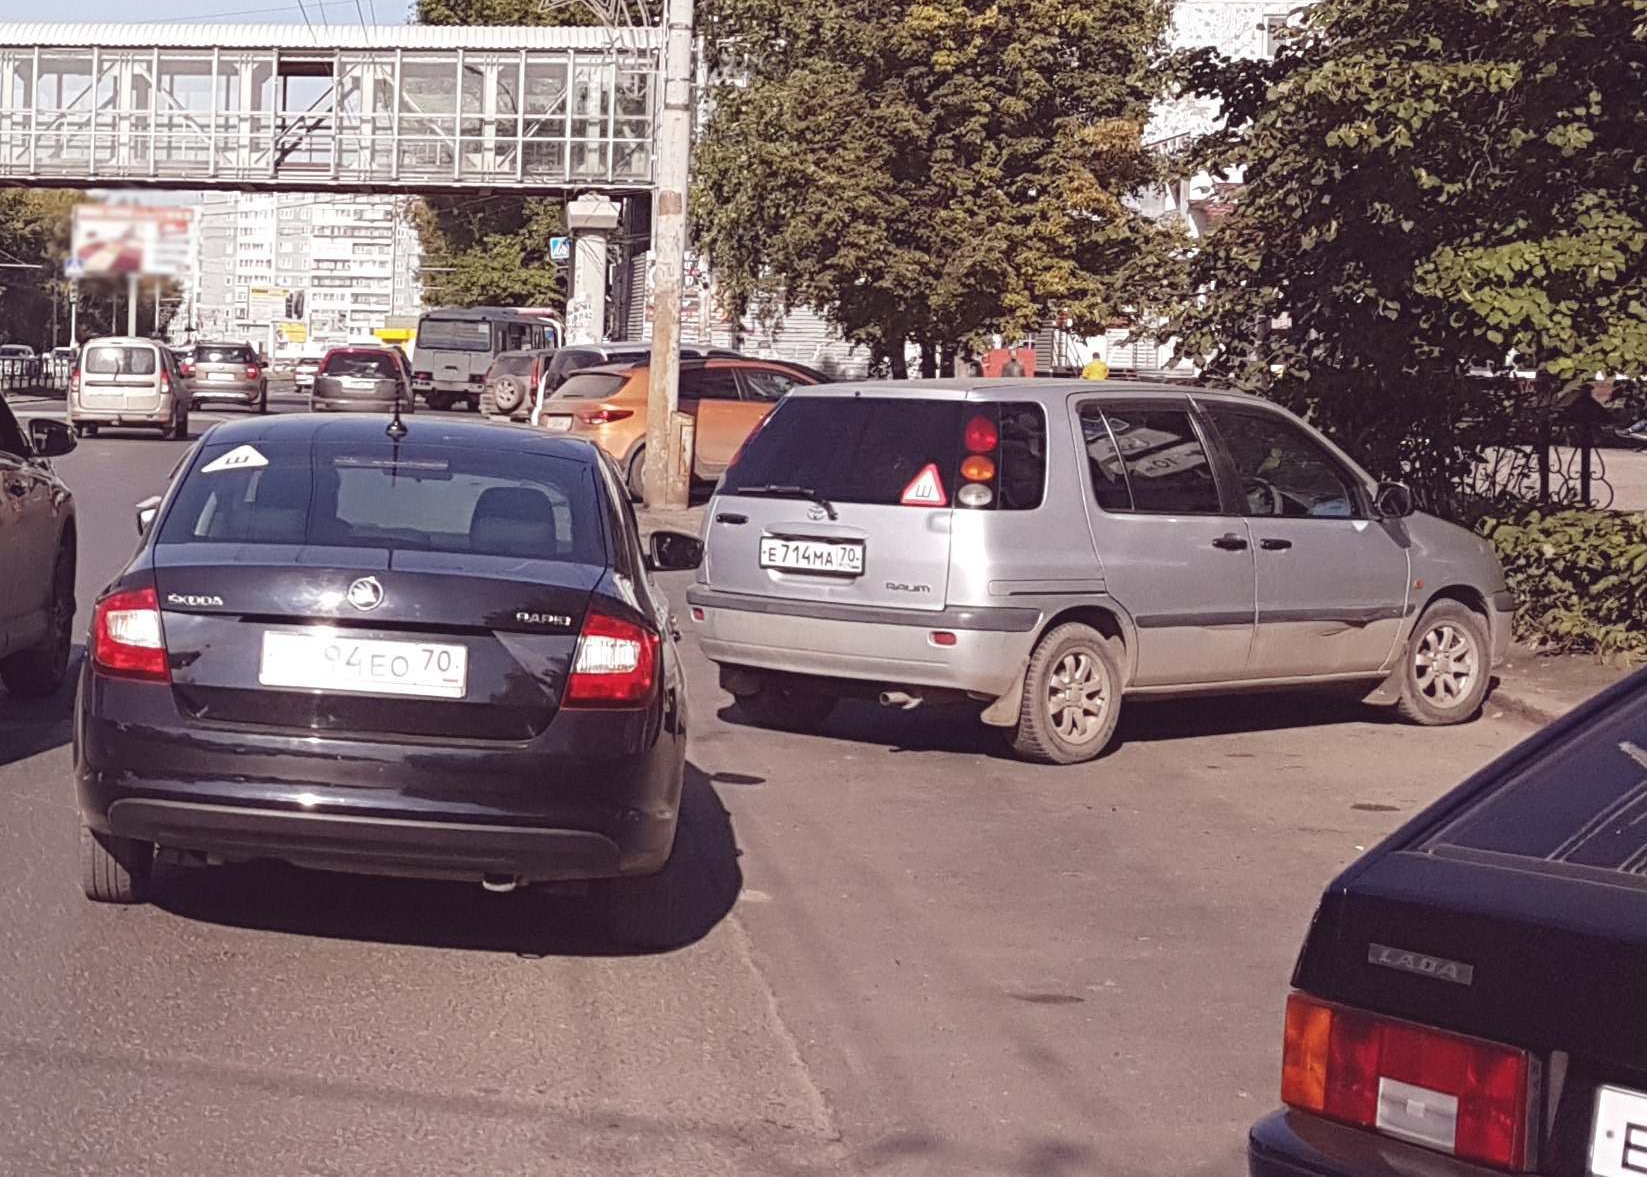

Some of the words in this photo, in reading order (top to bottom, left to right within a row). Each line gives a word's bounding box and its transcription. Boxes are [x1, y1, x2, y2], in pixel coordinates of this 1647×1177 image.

[840, 547, 855, 562] 70
[421, 648, 452, 672] 70
[1379, 949, 1458, 978] LADA
